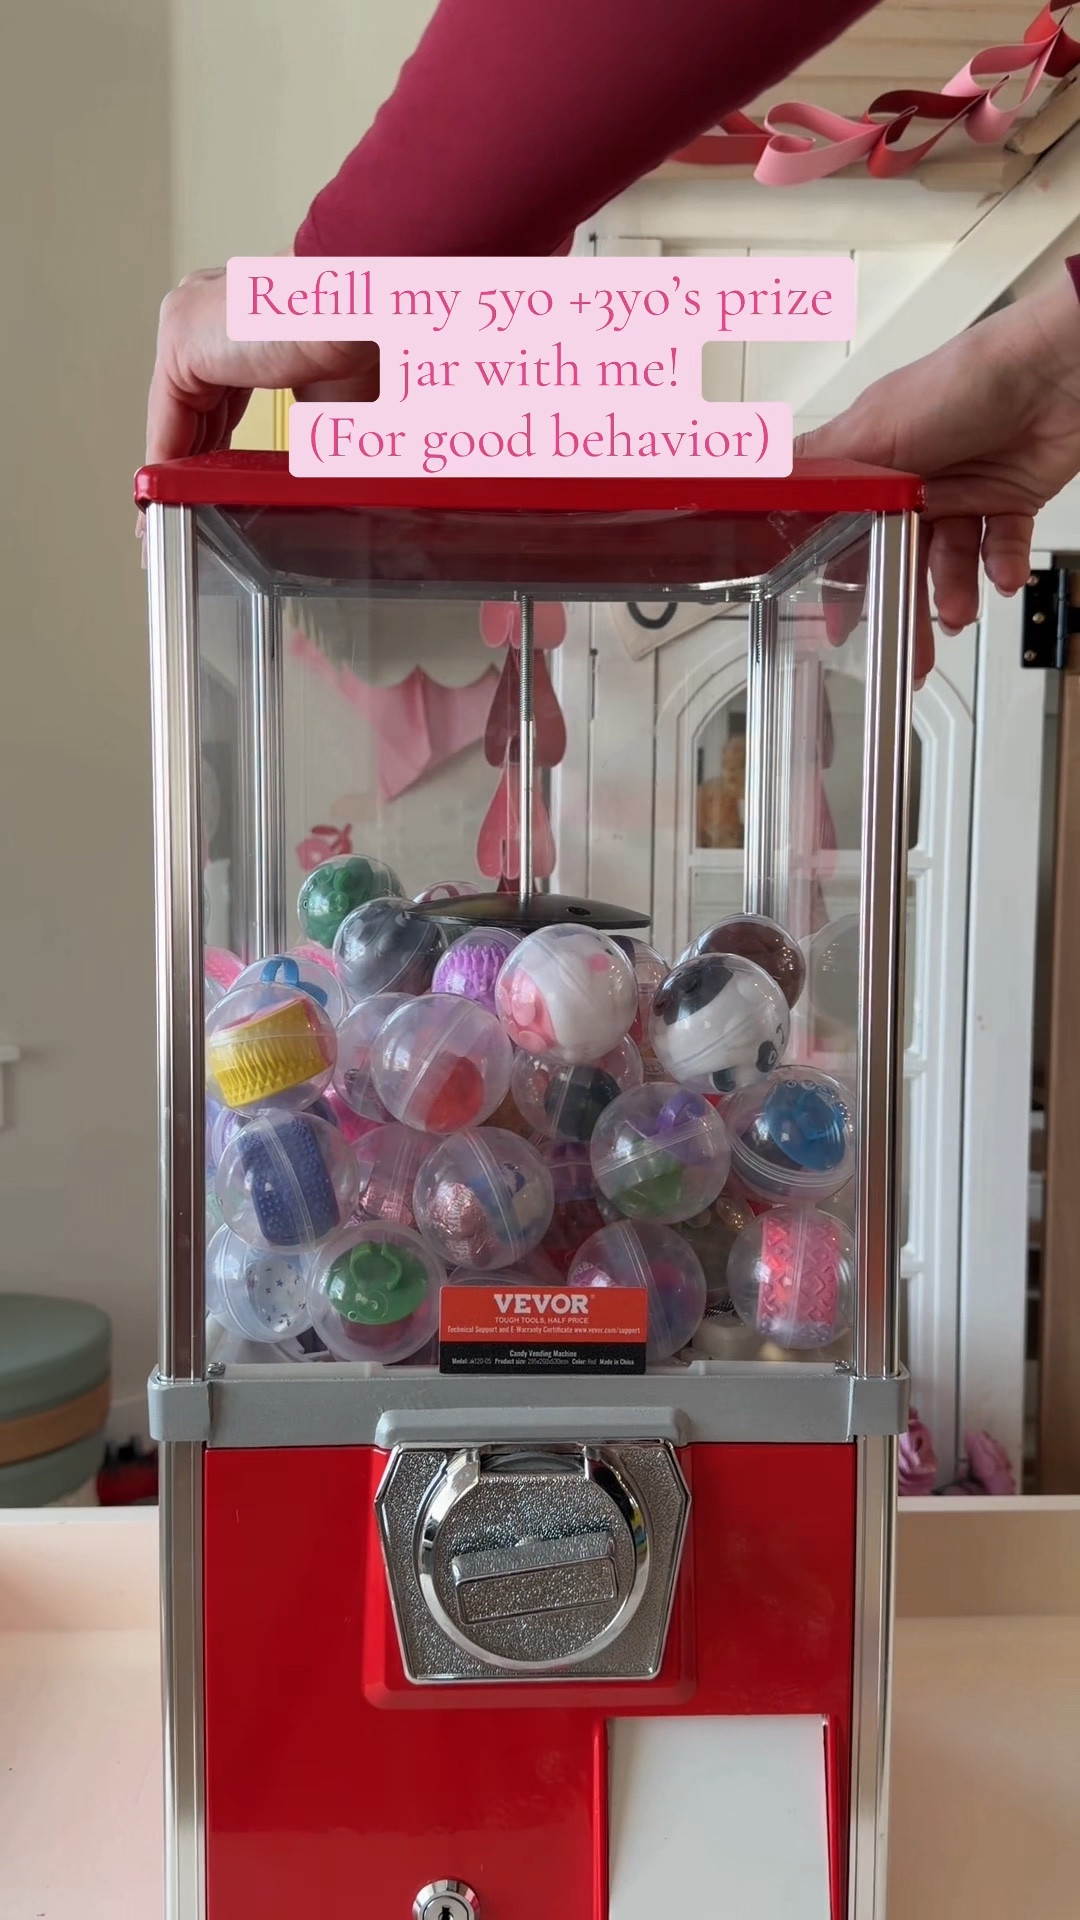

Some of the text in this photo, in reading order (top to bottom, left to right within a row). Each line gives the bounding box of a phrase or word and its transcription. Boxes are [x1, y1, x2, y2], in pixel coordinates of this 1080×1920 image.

[493, 1293, 589, 1315] VEVOR
[495, 1316, 520, 1324] TOUGH
[447, 1325, 475, 1333] Technical
[475, 1325, 498, 1334] Support
[542, 1326, 573, 1334] Certificate
[573, 1327, 641, 1335] www.vevor.com/support
[509, 1349, 577, 1358] Candy Vending Machine
[494, 1357, 515, 1365] Product
[599, 1358, 613, 1366] Made
[613, 1358, 619, 1366] in
[619, 1358, 635, 1366] China
